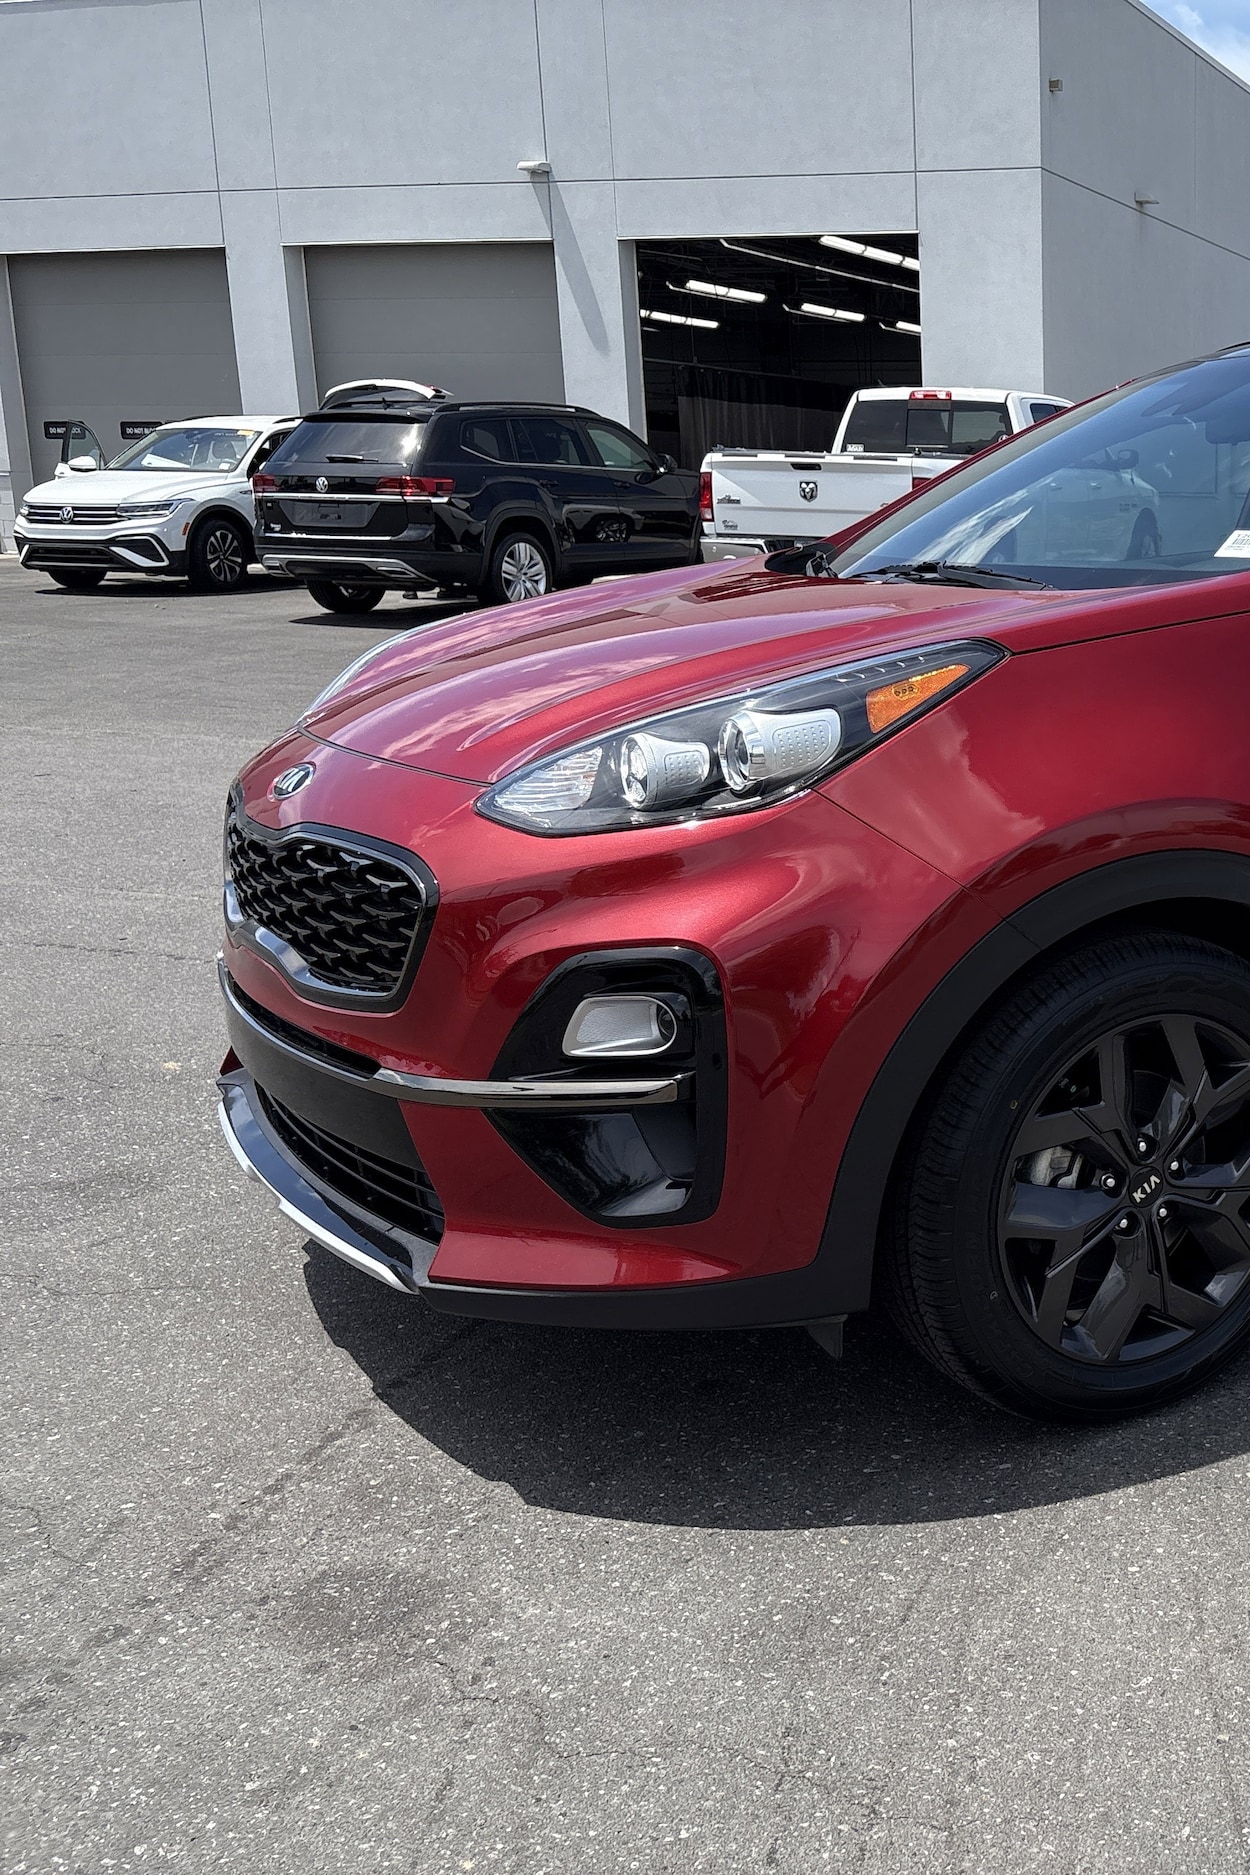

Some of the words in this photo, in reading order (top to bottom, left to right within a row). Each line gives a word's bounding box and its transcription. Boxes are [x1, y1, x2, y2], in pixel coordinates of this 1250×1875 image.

[126, 427, 133, 435] DO
[134, 427, 144, 435] NOT
[1132, 1174, 1161, 1204] KIA
